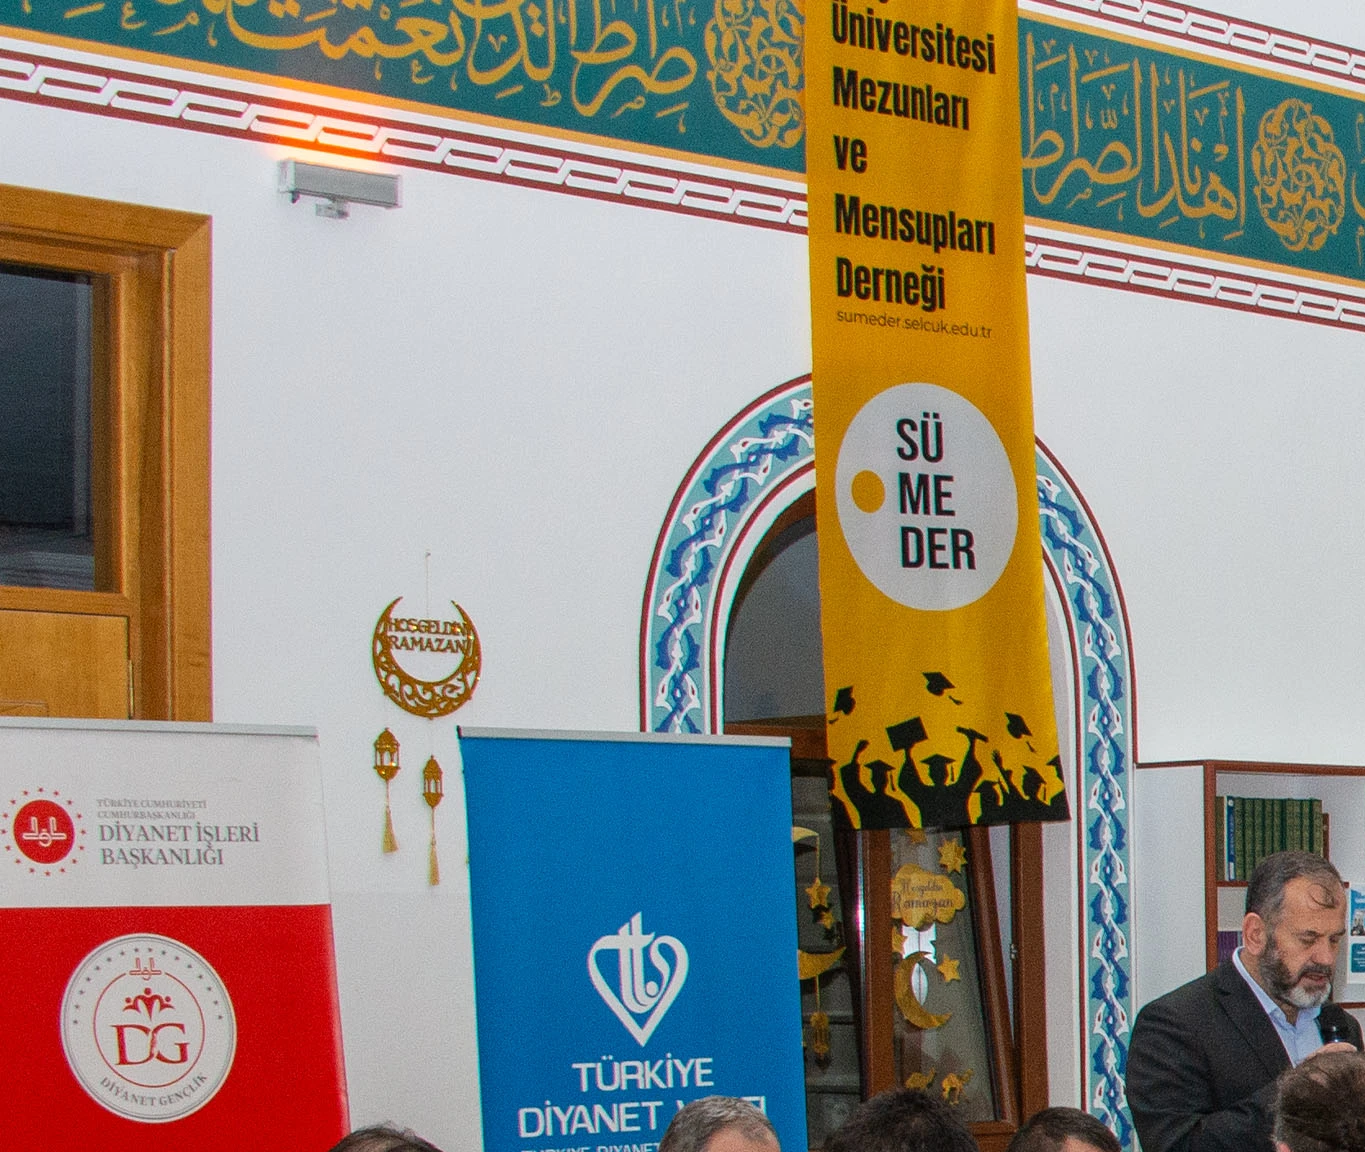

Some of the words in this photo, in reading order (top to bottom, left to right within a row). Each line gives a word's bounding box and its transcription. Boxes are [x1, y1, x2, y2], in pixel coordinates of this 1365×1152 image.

[832, 0, 996, 75] Üniversitesi
[833, 66, 970, 131] Mezunları
[833, 134, 868, 174] ve
[835, 193, 996, 255] Mensupları
[836, 256, 946, 313] Derneği
[896, 411, 944, 463] SÜ
[898, 471, 956, 517] ME
[900, 525, 977, 571] DER
[389, 635, 466, 654] RAMAZAN
[99, 821, 192, 842] DİYANET
[196, 822, 261, 846] İŞLERİ
[102, 845, 225, 869] BAŞKANLIĞI
[572, 1052, 715, 1093] TÜRKİYE
[518, 1100, 664, 1139] DİYANET
